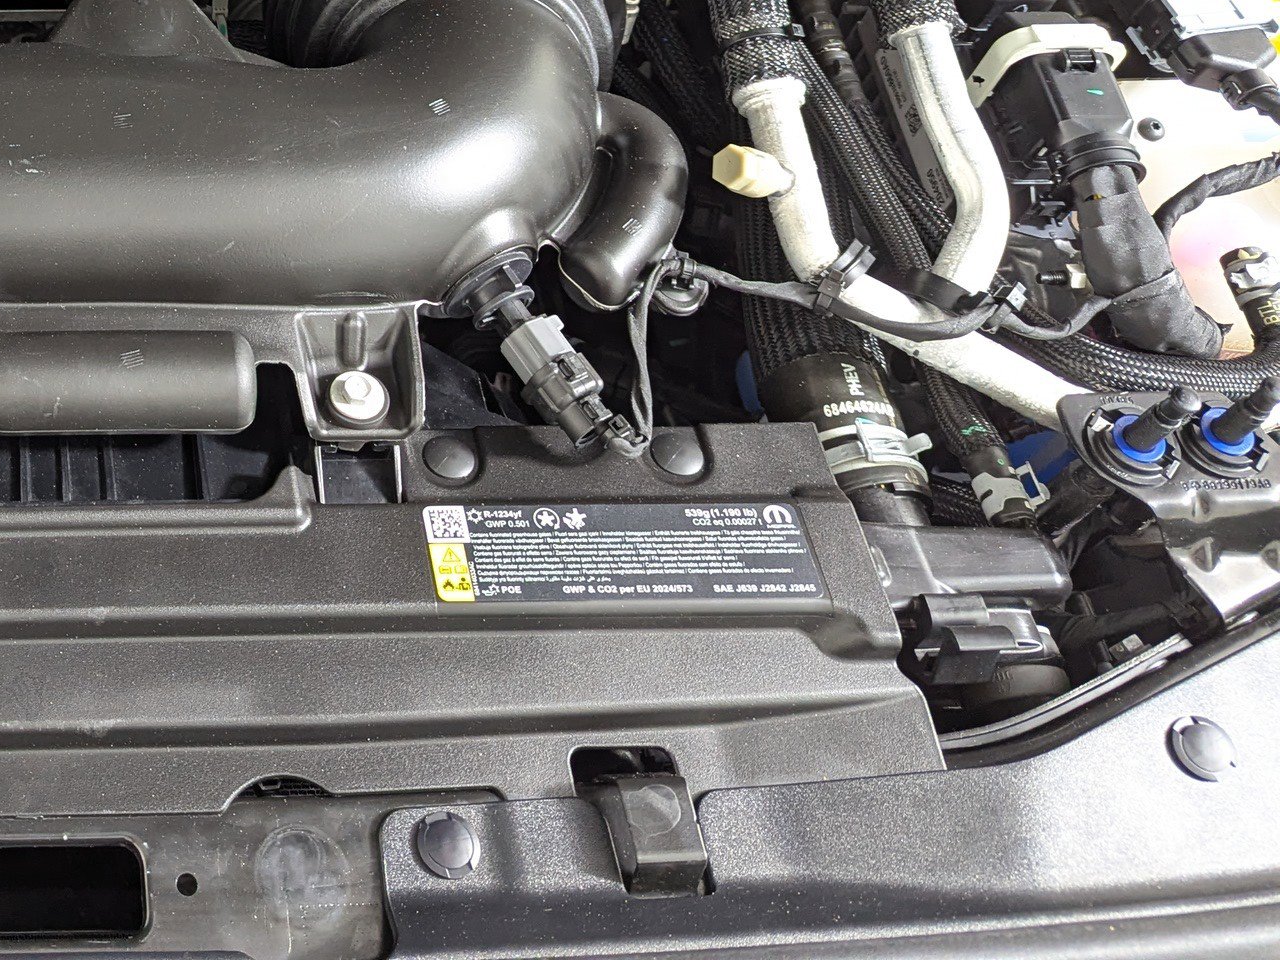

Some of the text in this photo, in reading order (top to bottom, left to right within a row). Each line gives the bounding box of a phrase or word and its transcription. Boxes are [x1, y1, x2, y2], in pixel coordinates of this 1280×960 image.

[840, 362, 865, 396] PHEV
[483, 510, 522, 519] R-1234yf
[485, 520, 530, 528] GWP 0.501
[692, 518, 711, 526] CO2
[502, 585, 522, 594] POE
[562, 586, 586, 594] GWP
[597, 586, 618, 594] CO2
[619, 586, 635, 595] per
[636, 585, 650, 593] EU
[652, 585, 693, 593] 2024/573
